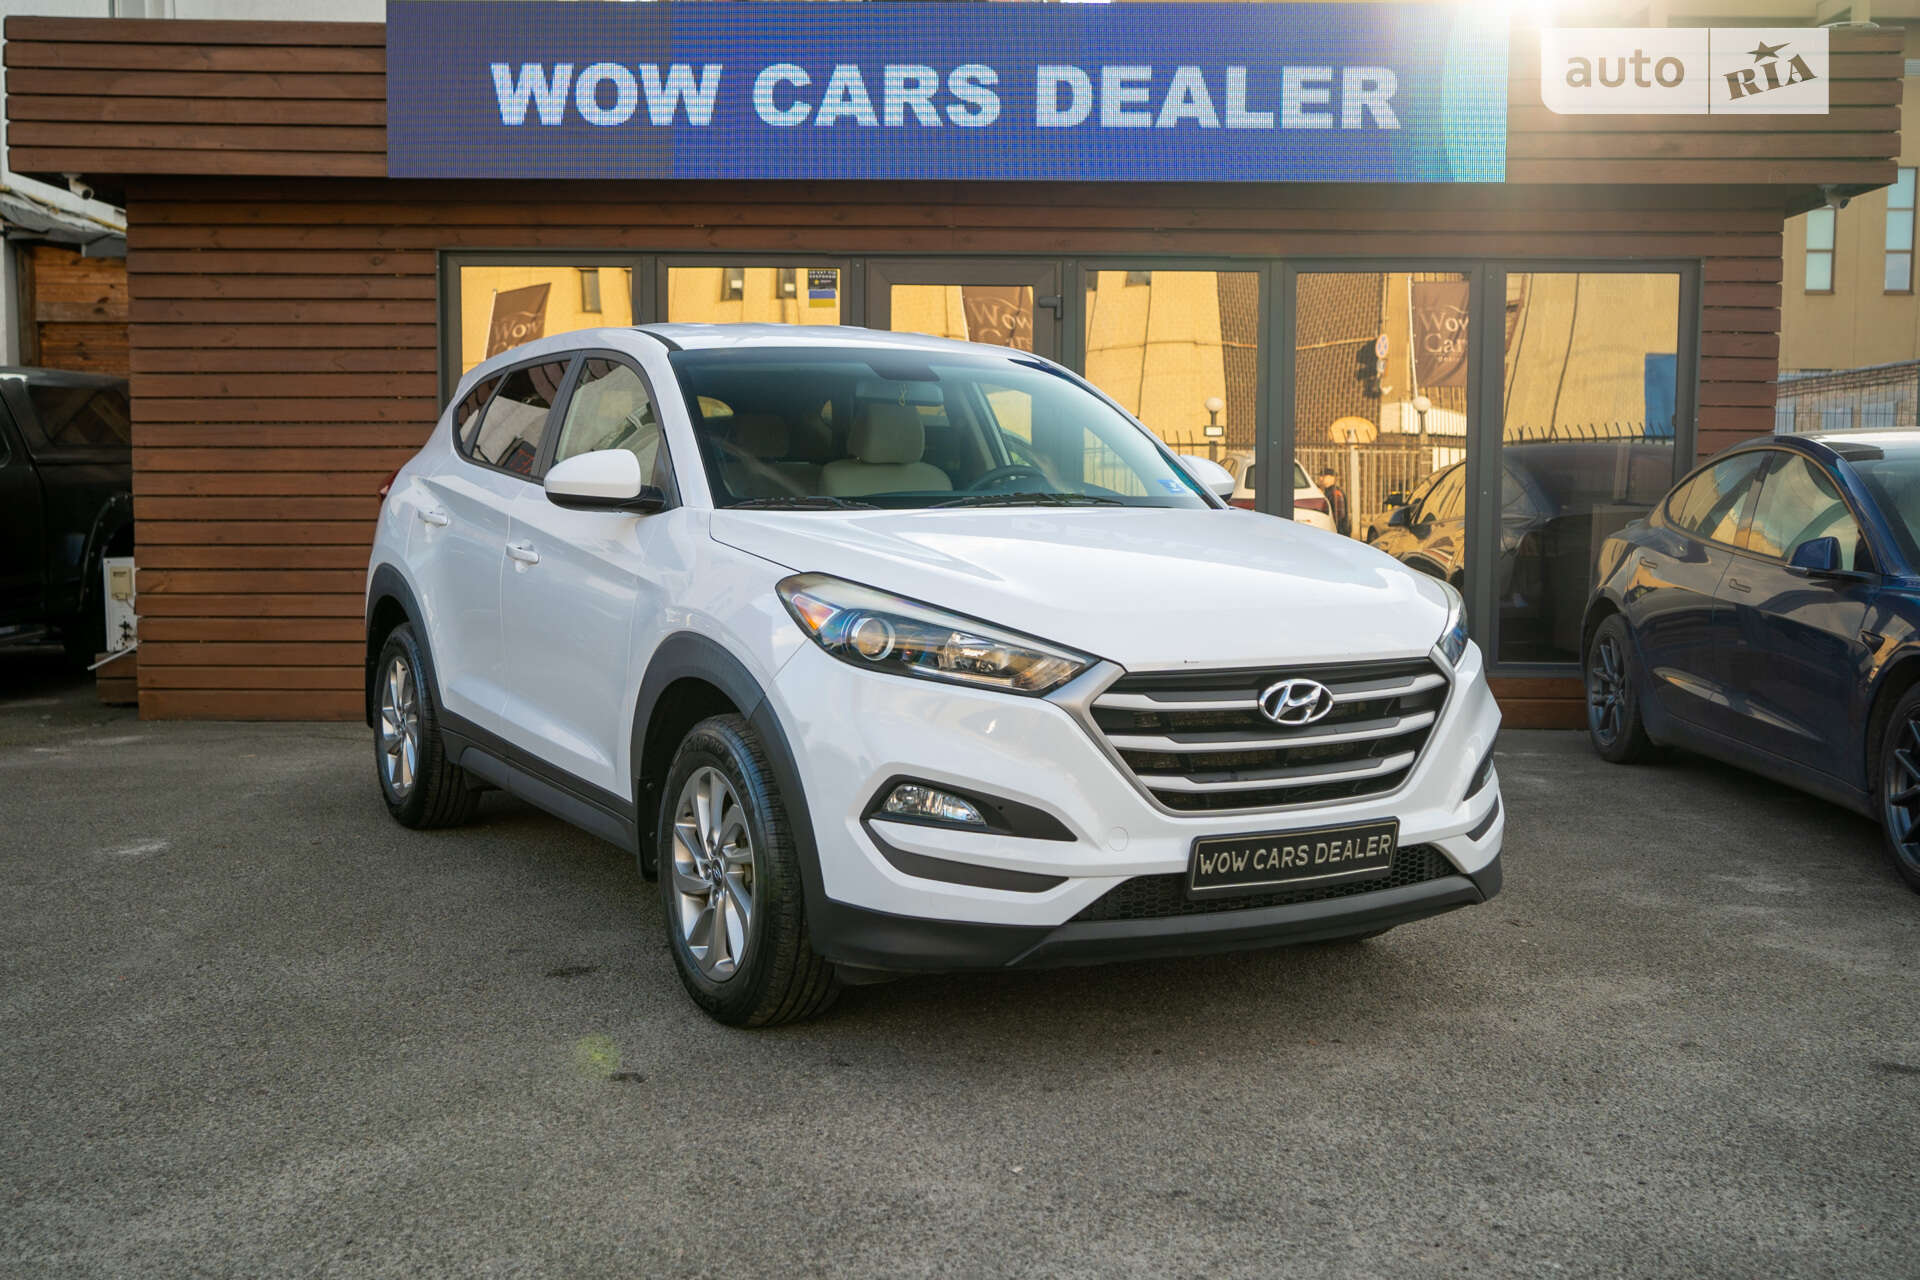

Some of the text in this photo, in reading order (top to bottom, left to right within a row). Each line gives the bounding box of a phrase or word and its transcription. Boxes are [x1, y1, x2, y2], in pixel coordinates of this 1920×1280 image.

[490, 62, 1401, 129] WOW CARS DEALER
[1200, 834, 1392, 875] WOW CARS DEALER
